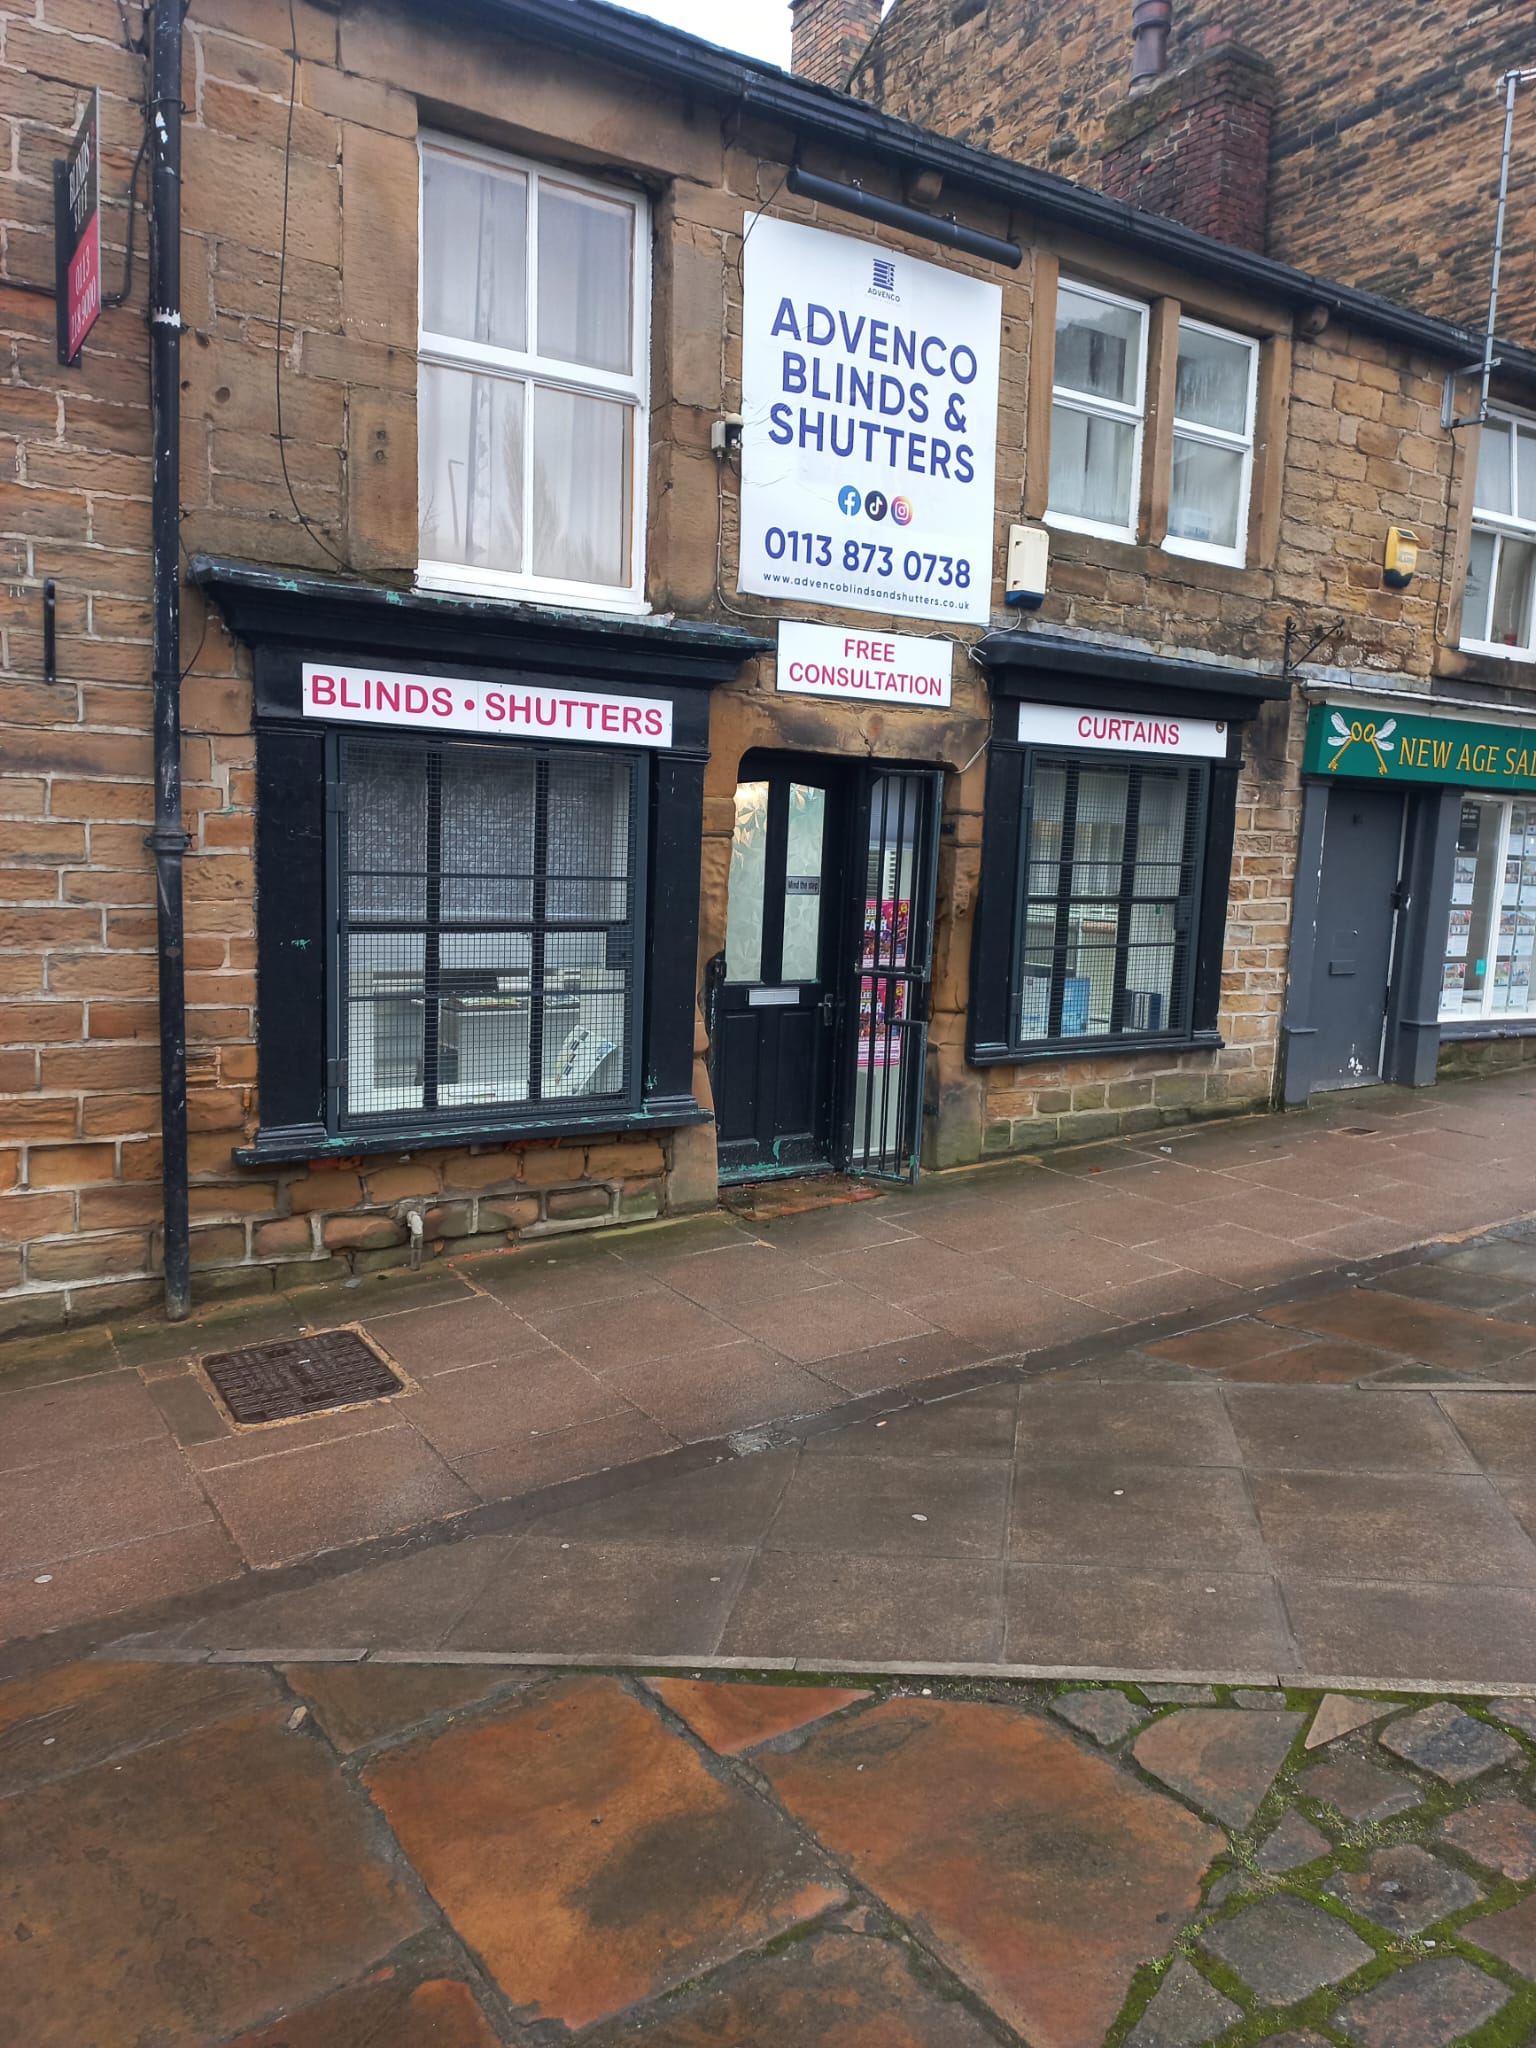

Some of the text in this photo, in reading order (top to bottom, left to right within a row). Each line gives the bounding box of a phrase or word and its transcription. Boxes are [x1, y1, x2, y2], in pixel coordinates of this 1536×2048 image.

[75, 245, 90, 296] 0113
[867, 287, 901, 302] ADVENCO
[770, 297, 978, 385] ADVENCO
[782, 350, 967, 434] BLINDS &
[768, 402, 975, 484] SHUTTERS
[765, 527, 971, 588] 0113 873 0738
[763, 572, 970, 611] www.advencoblindsandshutters.co.uk
[844, 638, 896, 663] FREE
[789, 662, 942, 697] CONSULTATION
[311, 674, 663, 736] BLINDS SHUTTERS
[1077, 715, 1180, 746] CURTAINS
[1398, 736, 1454, 769] NEW
[1456, 743, 1500, 774] AGE
